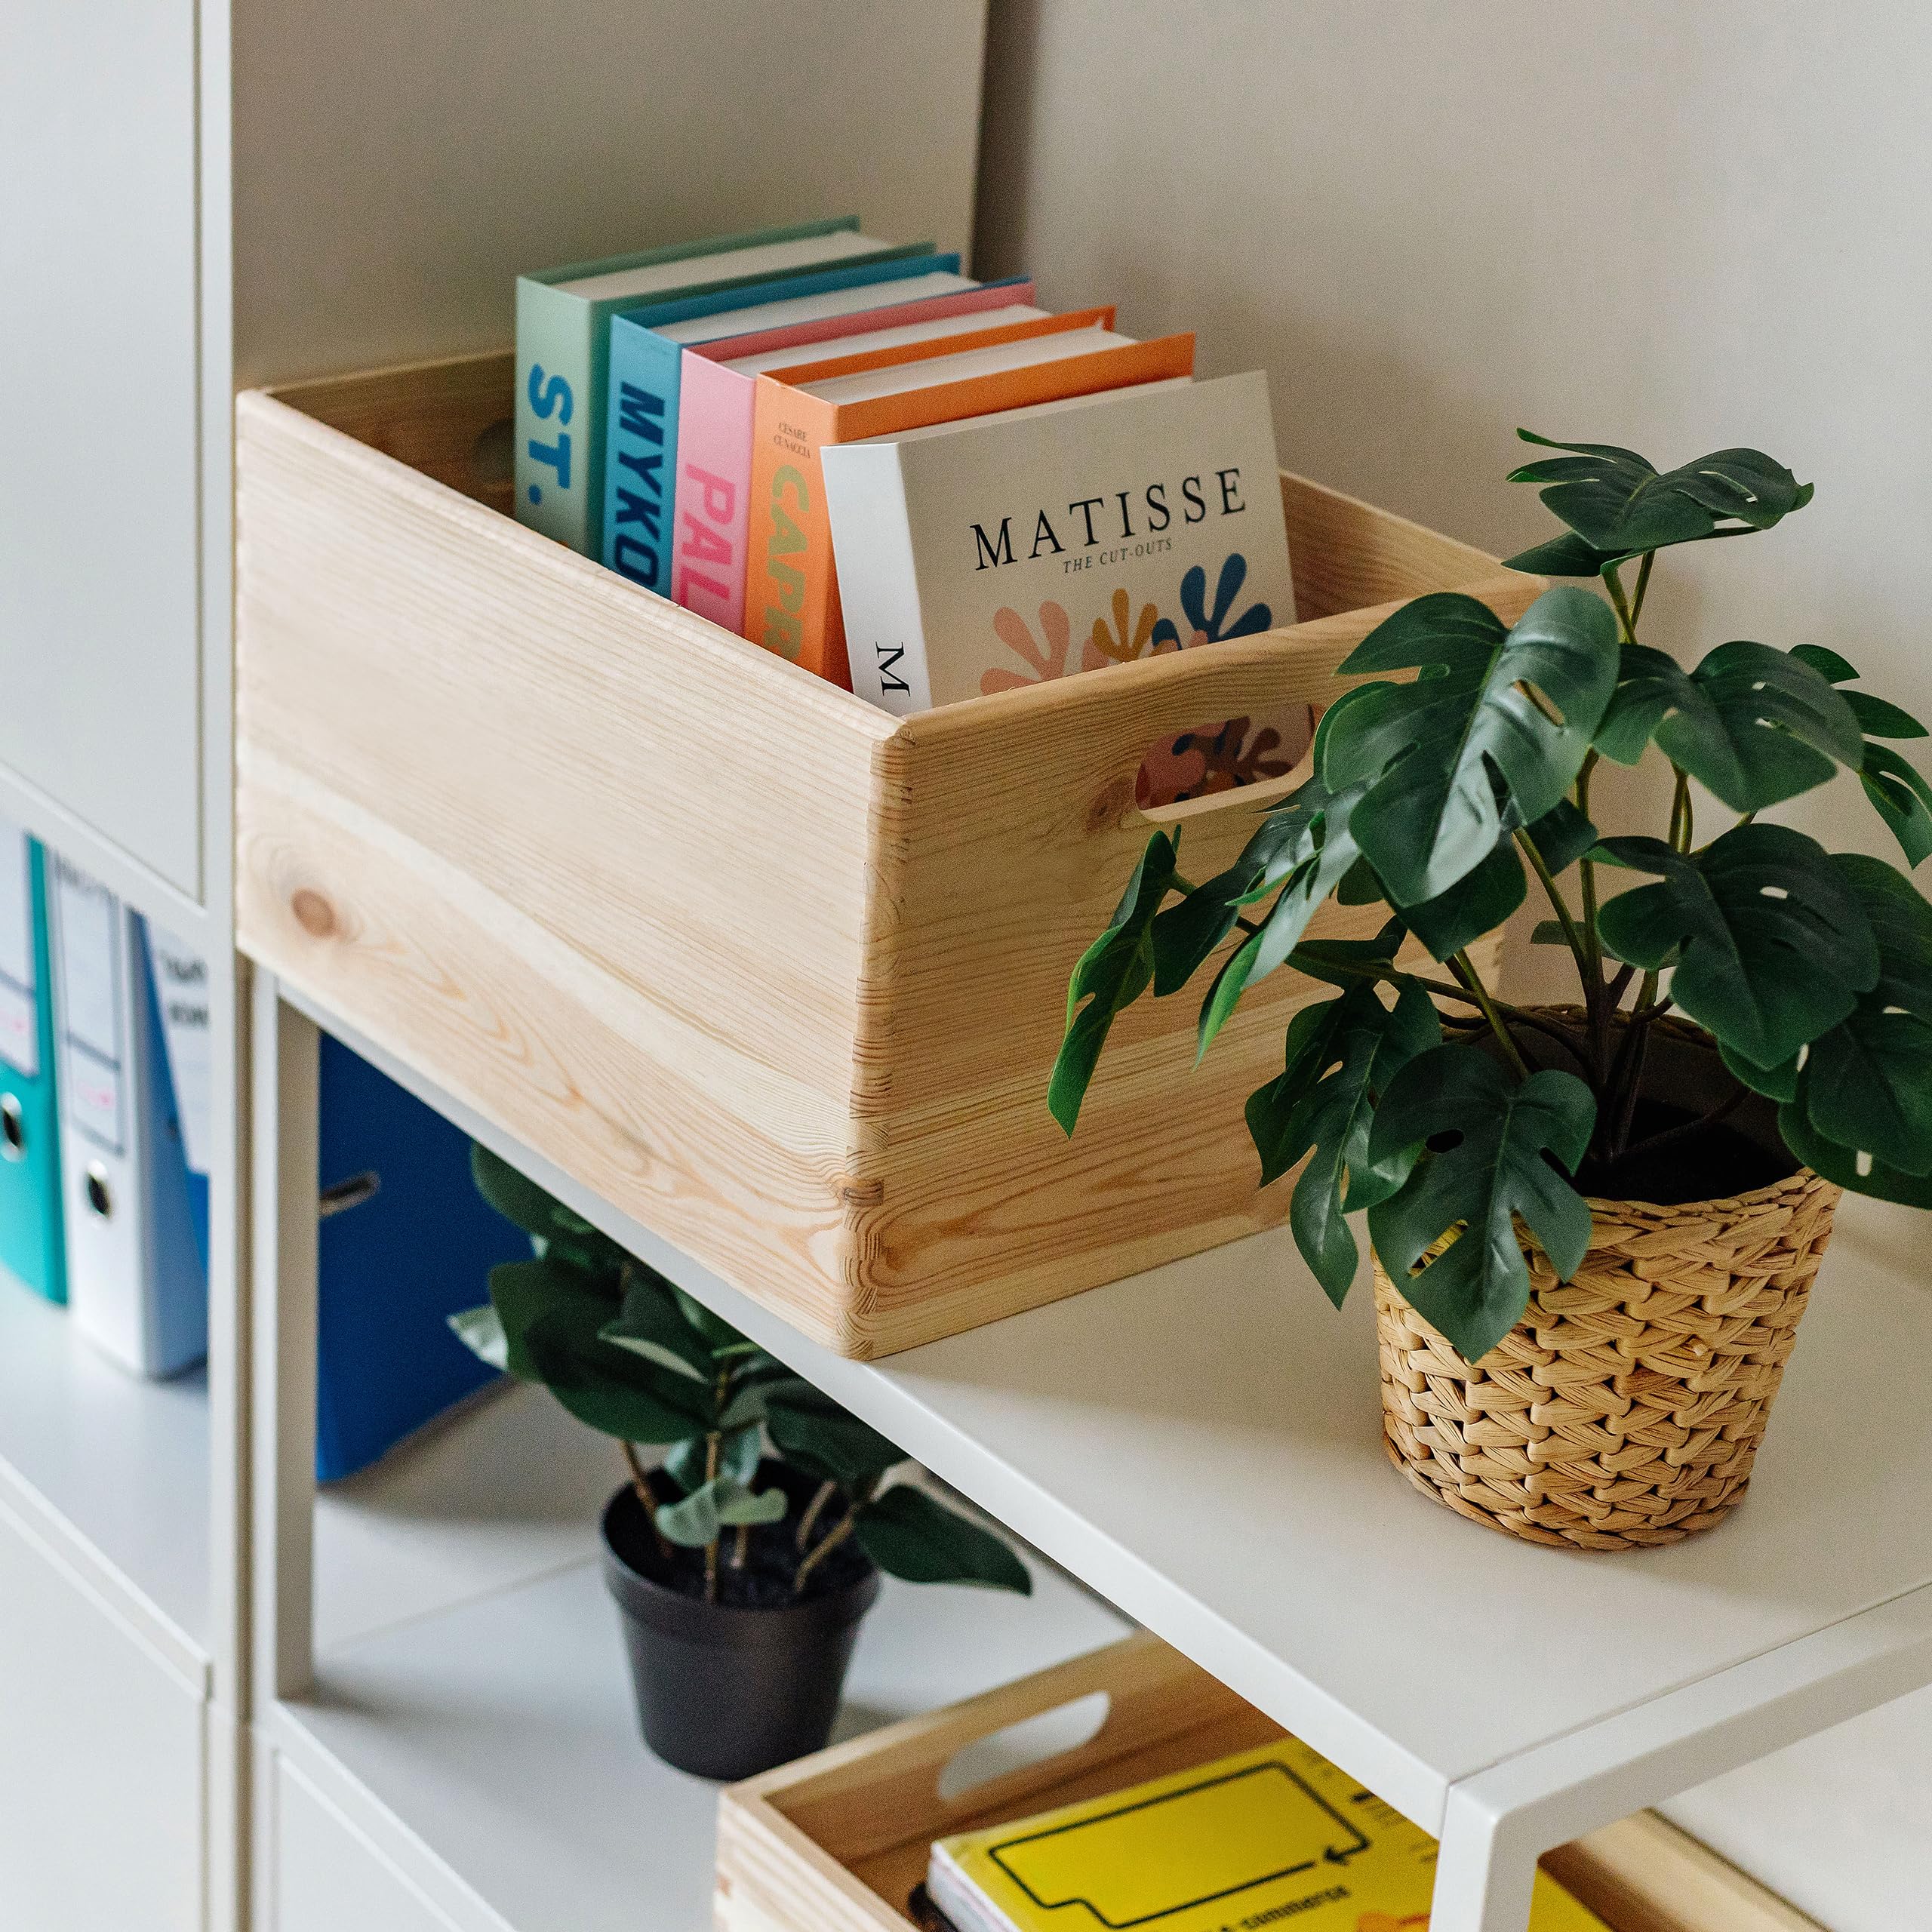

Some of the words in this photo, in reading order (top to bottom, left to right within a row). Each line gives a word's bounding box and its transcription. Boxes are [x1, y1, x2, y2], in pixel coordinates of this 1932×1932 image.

[528, 362, 574, 505] ST.
[778, 422, 807, 442] CESARE
[615, 380, 665, 589] MYKO
[681, 463, 736, 609] PAL
[970, 468, 1246, 571] MATISSE
[1063, 556, 1093, 574] THE
[1100, 537, 1173, 565] CUT-OUTS
[875, 641, 911, 697] M
